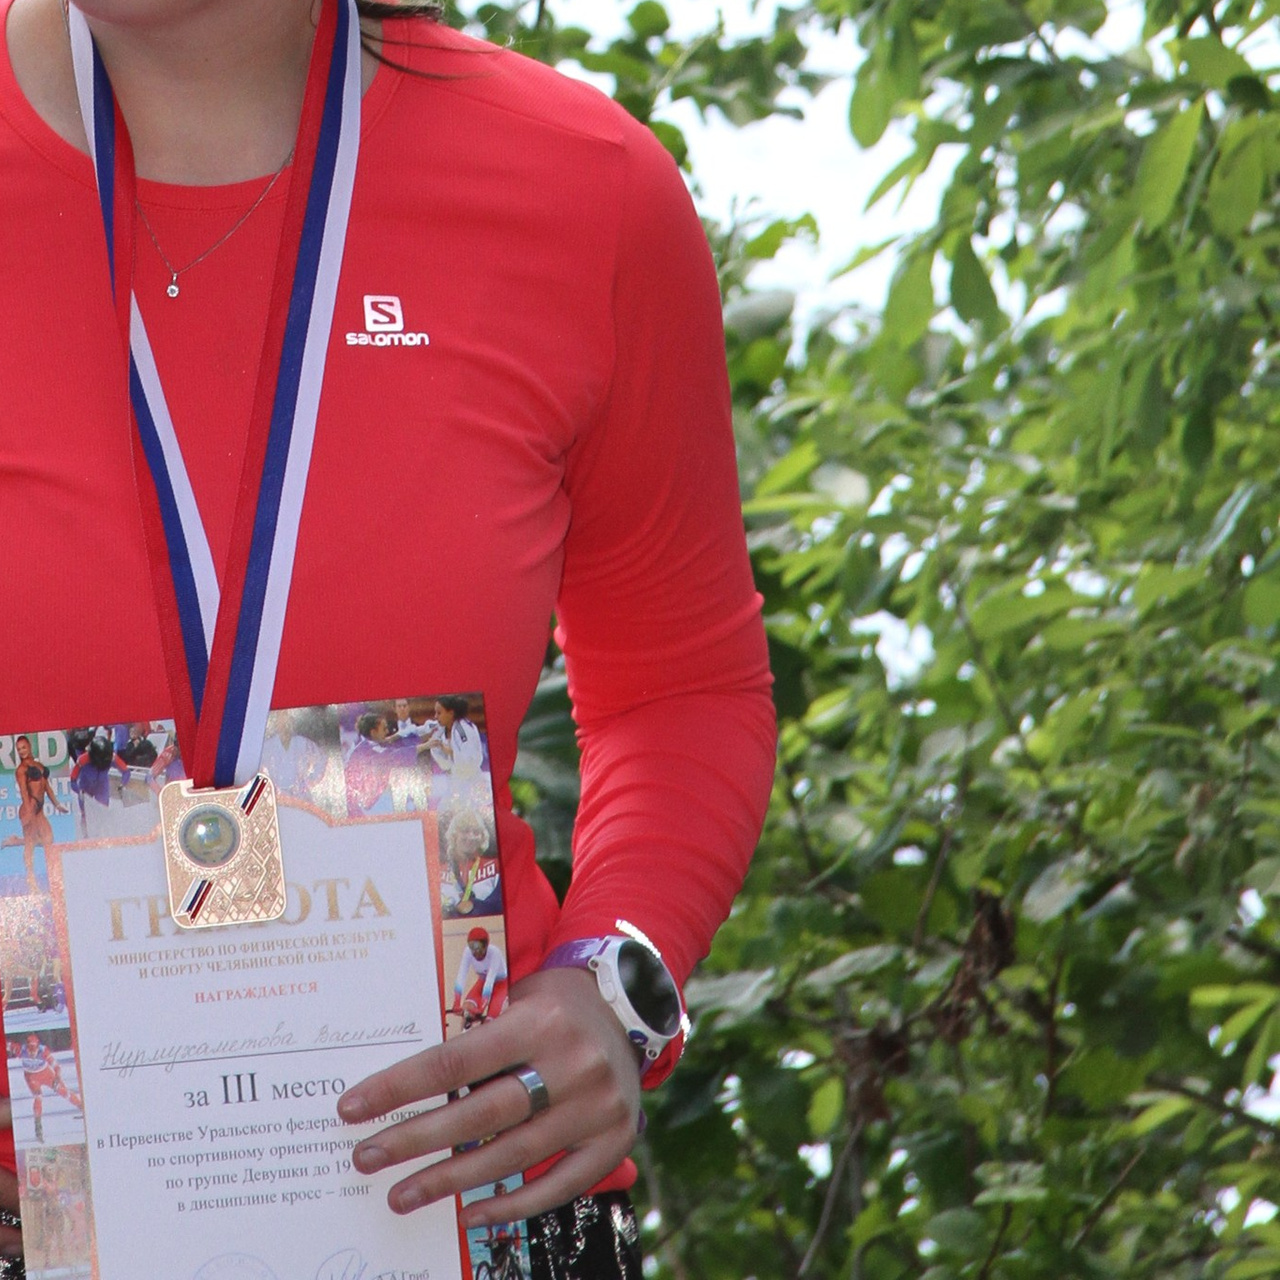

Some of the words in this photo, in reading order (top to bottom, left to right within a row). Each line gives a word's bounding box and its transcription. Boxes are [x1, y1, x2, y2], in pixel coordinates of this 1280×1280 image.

[108, 945, 214, 967] МИНИСТЕРСТВО
[218, 942, 238, 957] ПО
[241, 931, 328, 955] ФИЗИЧЕСКОЙ
[138, 968, 148, 980] И
[151, 961, 203, 978] СПОРТУ
[207, 953, 304, 973] ЧЕЛЯБИНСКОЙ
[308, 947, 369, 963] ОБЛАСТИ
[194, 981, 319, 1003] НАГРАЖДАЕТСЯ
[183, 1089, 210, 1108] за
[220, 1072, 260, 1104] III
[271, 1077, 347, 1101] место
[96, 1140, 105, 1150] в
[108, 1128, 194, 1152] Первенстве
[198, 1121, 283, 1143] Уральского
[147, 1155, 166, 1169] по
[169, 1147, 266, 1171] спортивному
[165, 1177, 184, 1190] по
[187, 1171, 238, 1193] группе
[242, 1166, 309, 1184] Девушки
[313, 1164, 330, 1177] до
[335, 1160, 351, 1175] 19
[177, 1202, 186, 1212] в
[190, 1193, 277, 1213] дисциплине
[281, 1188, 322, 1206] кросс
[339, 1184, 372, 1197] лонг
